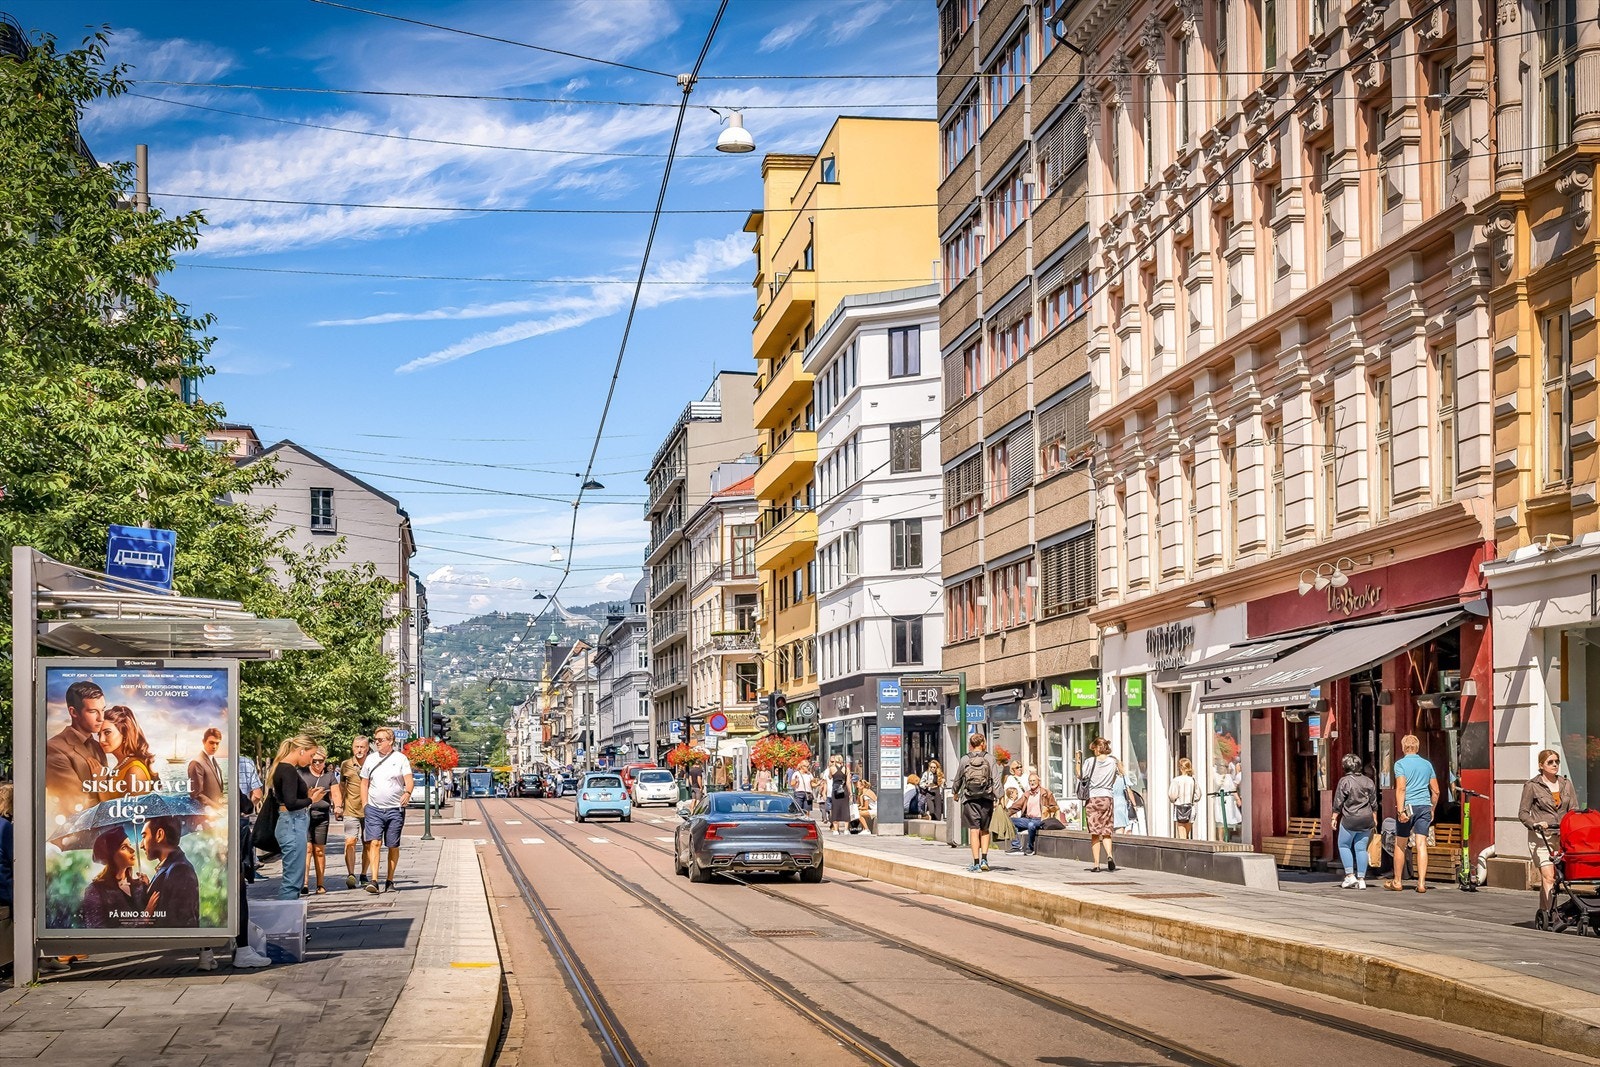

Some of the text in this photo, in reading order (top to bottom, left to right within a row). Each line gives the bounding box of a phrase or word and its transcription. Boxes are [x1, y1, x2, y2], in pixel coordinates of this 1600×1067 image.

[1325, 584, 1382, 615] The Broker
[672, 723, 680, 732] P
[100, 766, 120, 777] Det
[82, 773, 195, 793] siste brevet
[108, 799, 148, 825] deg
[109, 909, 167, 918] PÅ KINO 30. JULI
